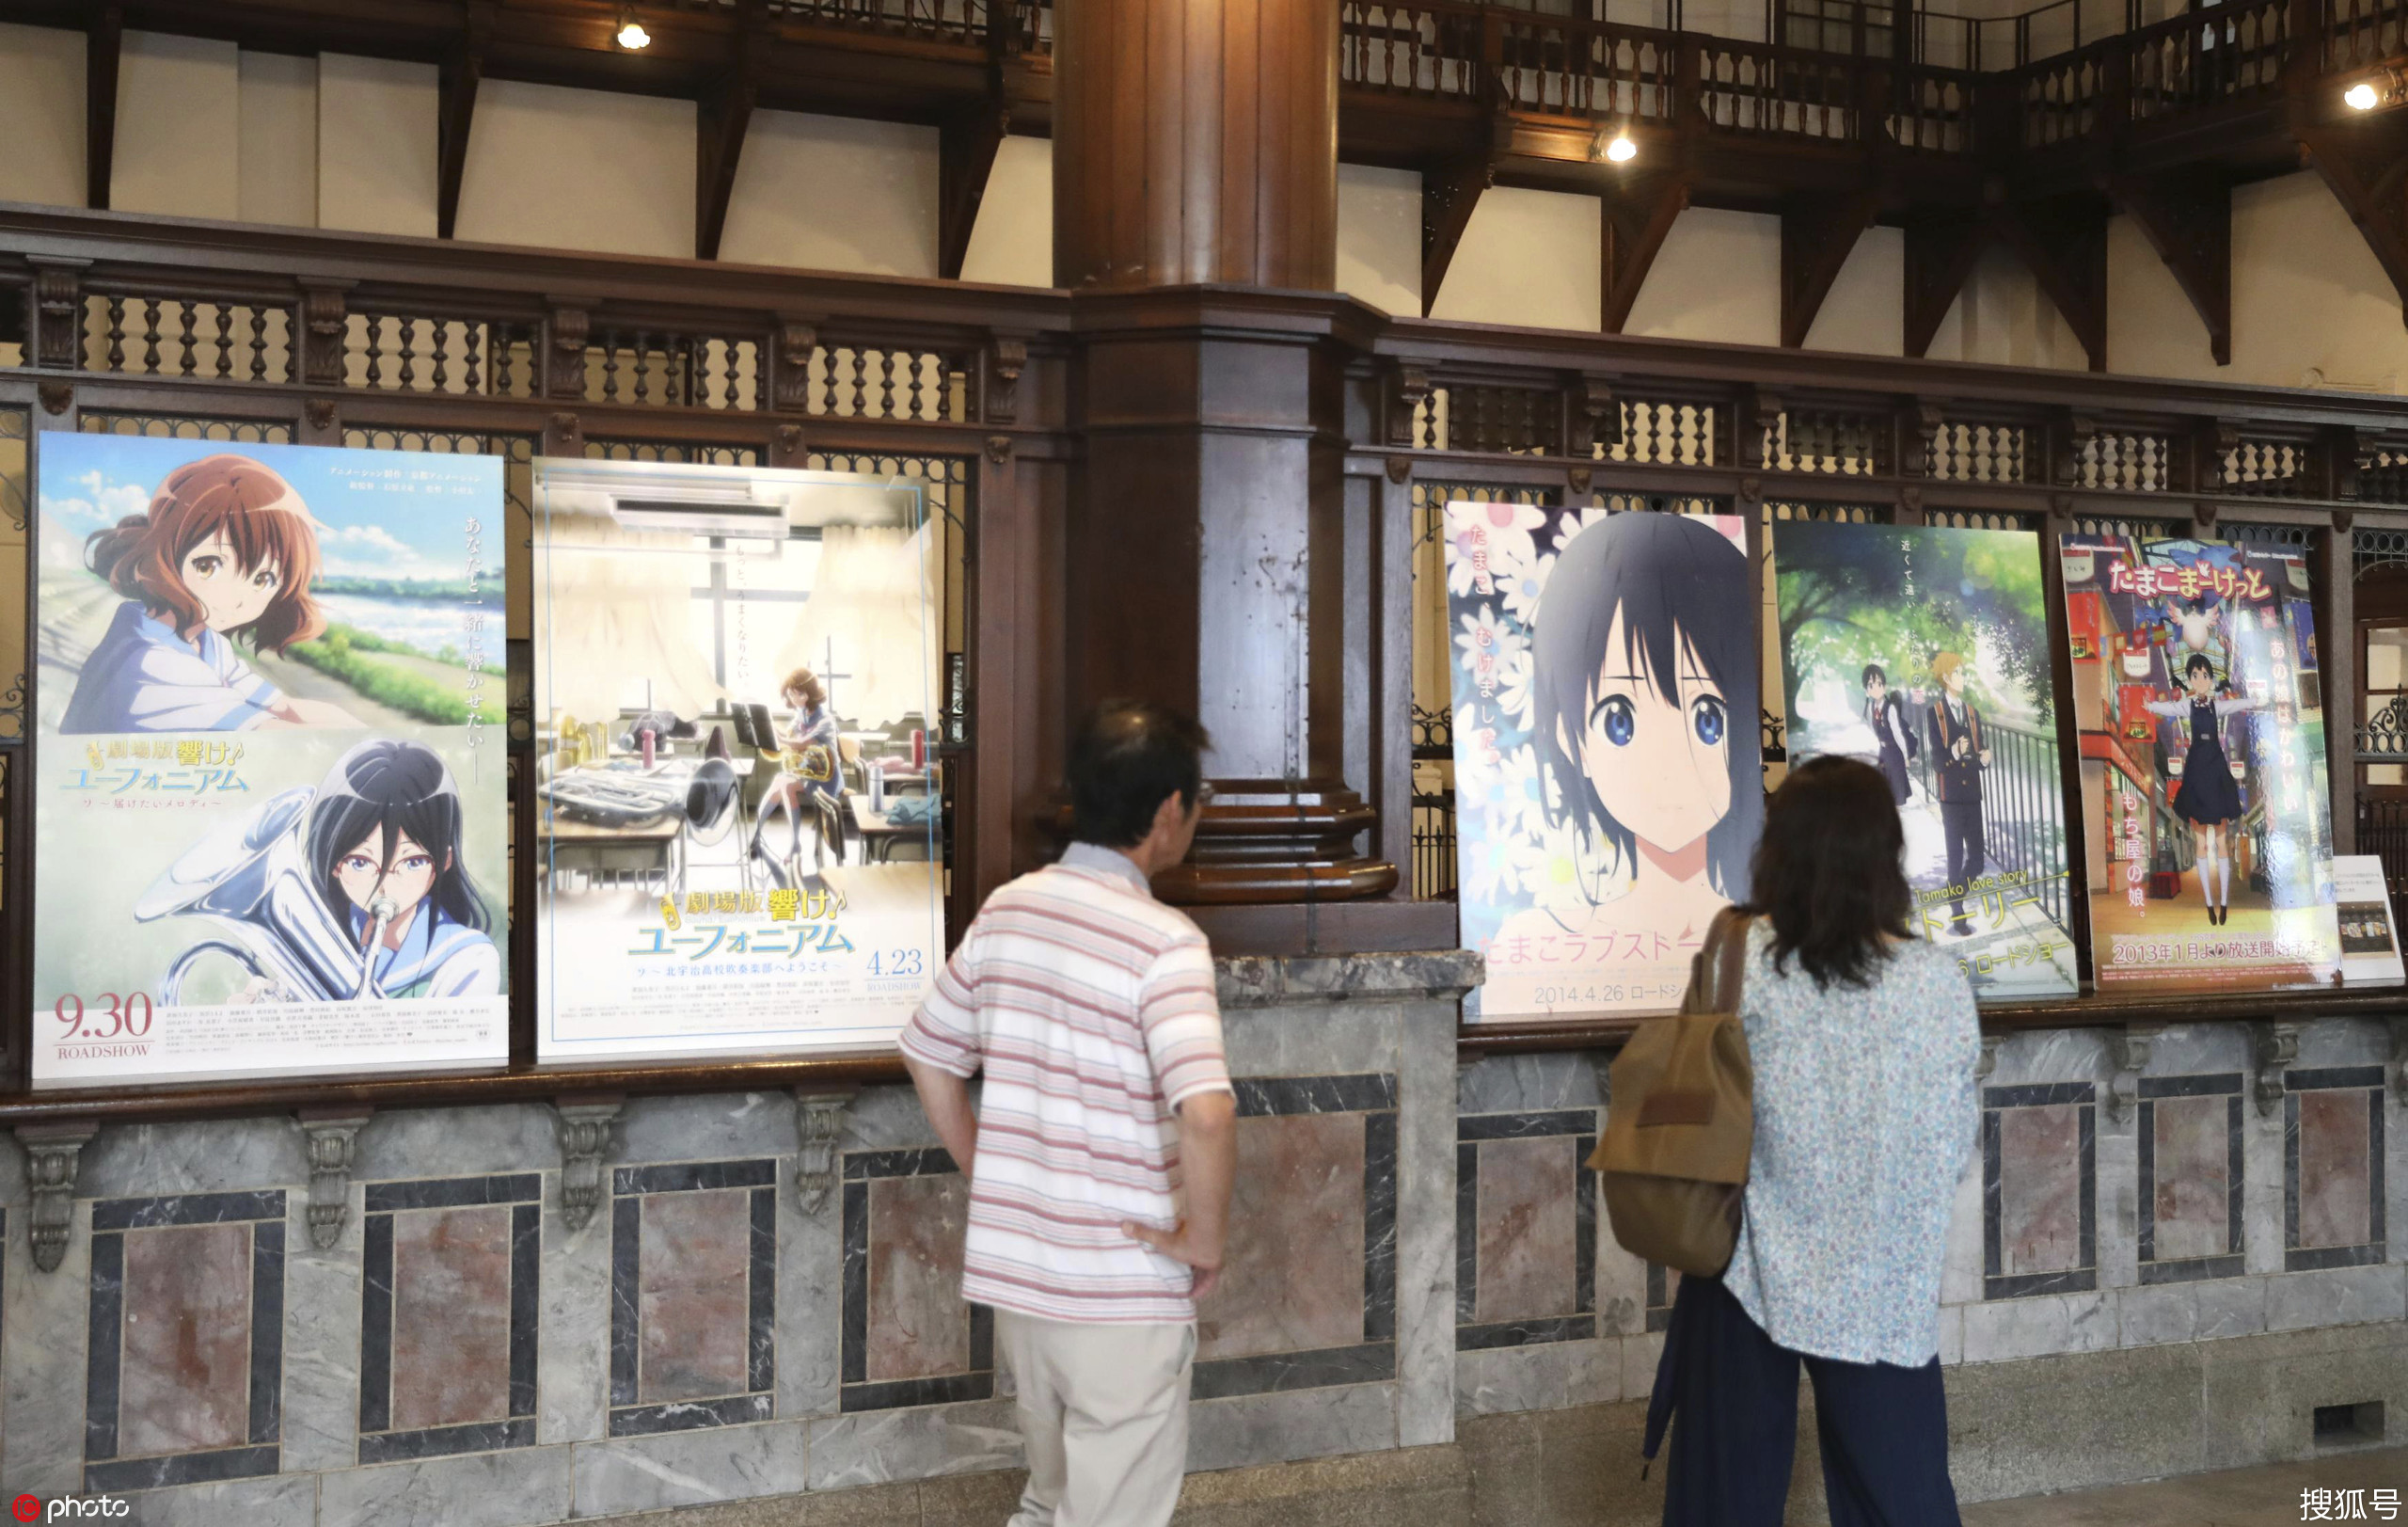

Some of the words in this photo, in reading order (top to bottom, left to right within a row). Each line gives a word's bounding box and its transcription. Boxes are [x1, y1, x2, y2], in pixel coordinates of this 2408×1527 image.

[2108, 559, 2272, 600] たまこまーけっと
[59, 768, 250, 795] ユーフォニアム
[2122, 791, 2147, 918] もち屋の娘。
[1915, 881, 1965, 904] Tamako
[1967, 876, 1994, 893] love
[1999, 869, 2029, 886] story
[1904, 891, 2040, 943] トーリー
[627, 923, 857, 961] ユーフォニアム
[866, 947, 924, 977] 4.23
[1975, 943, 2070, 975] ロードショー
[866, 981, 922, 993] ROADSHOW
[1534, 984, 1624, 1005] 2014.4.26
[1631, 983, 1687, 1000] ロードシ
[55, 991, 153, 1040] 9.30
[57, 1044, 151, 1060] ROADSHOW
